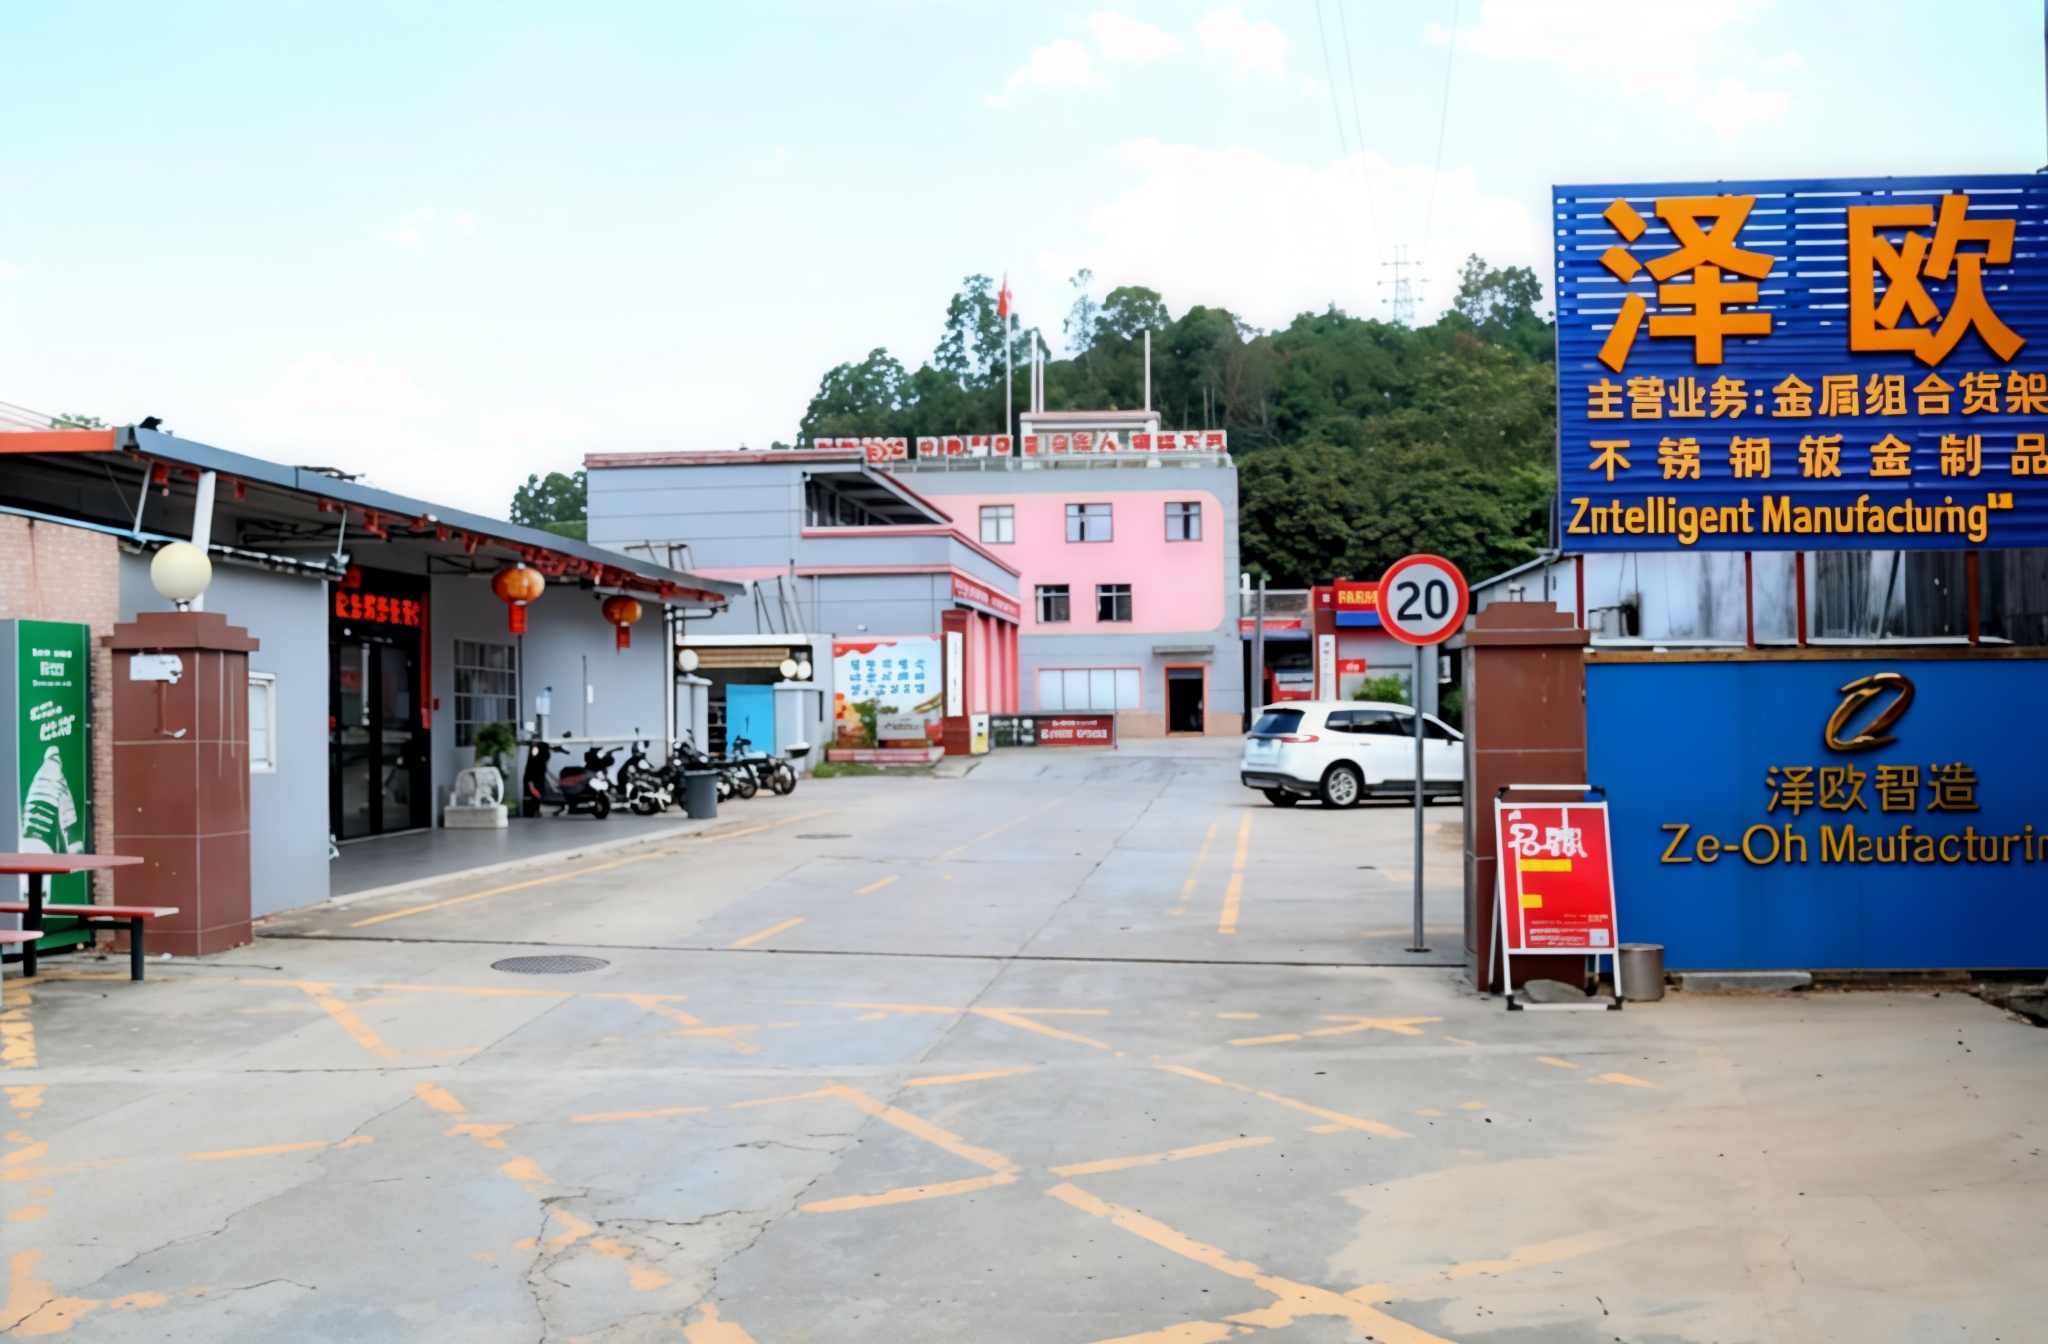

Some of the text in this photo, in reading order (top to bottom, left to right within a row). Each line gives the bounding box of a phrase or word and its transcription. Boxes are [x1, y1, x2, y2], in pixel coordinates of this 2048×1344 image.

[1597, 194, 2026, 373] 泽欧
[1397, 579, 1449, 621] 20
[1766, 762, 1980, 815] 泽欧智造
[1661, 823, 1807, 865] Ze-Oh
